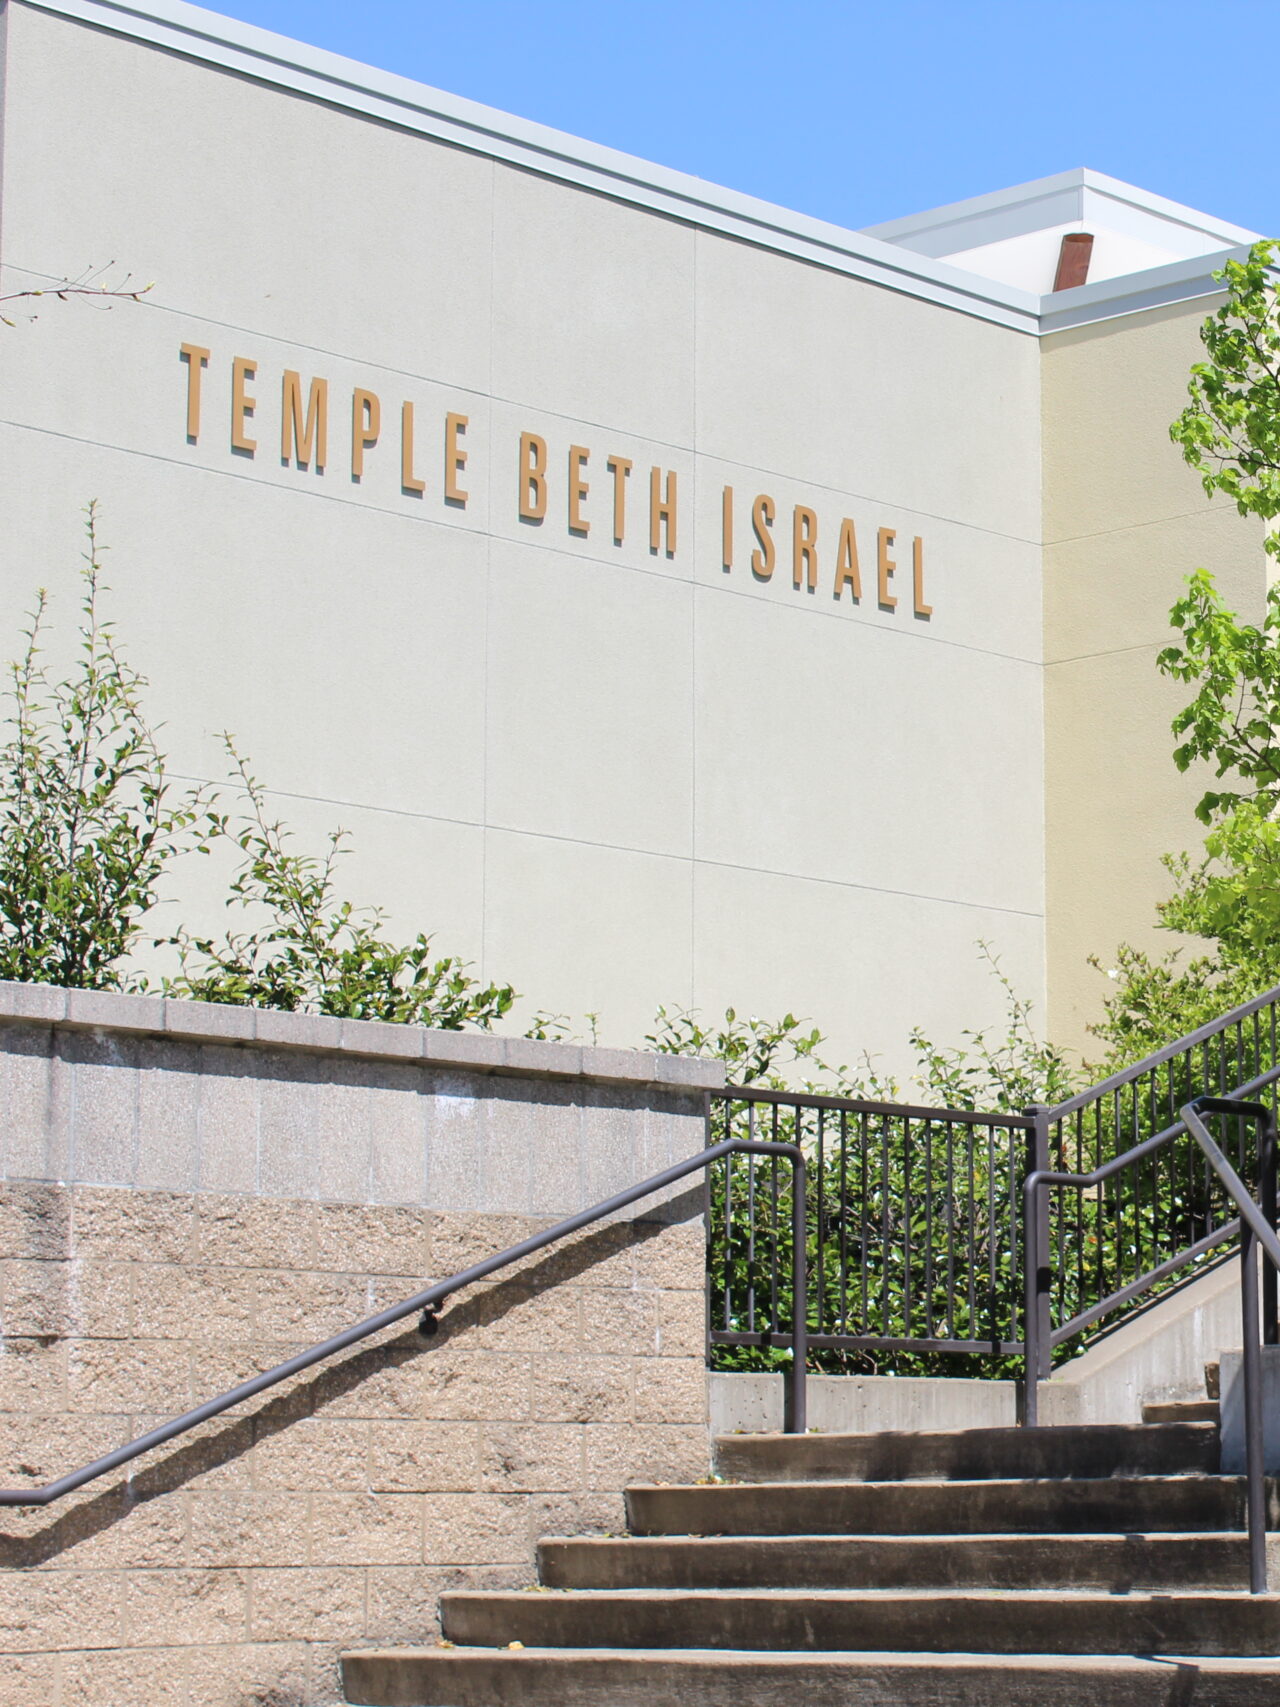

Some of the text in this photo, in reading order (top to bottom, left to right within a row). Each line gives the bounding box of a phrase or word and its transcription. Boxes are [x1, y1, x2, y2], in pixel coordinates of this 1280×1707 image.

[180, 343, 933, 616] TEMPLE BETH ISRAEL
